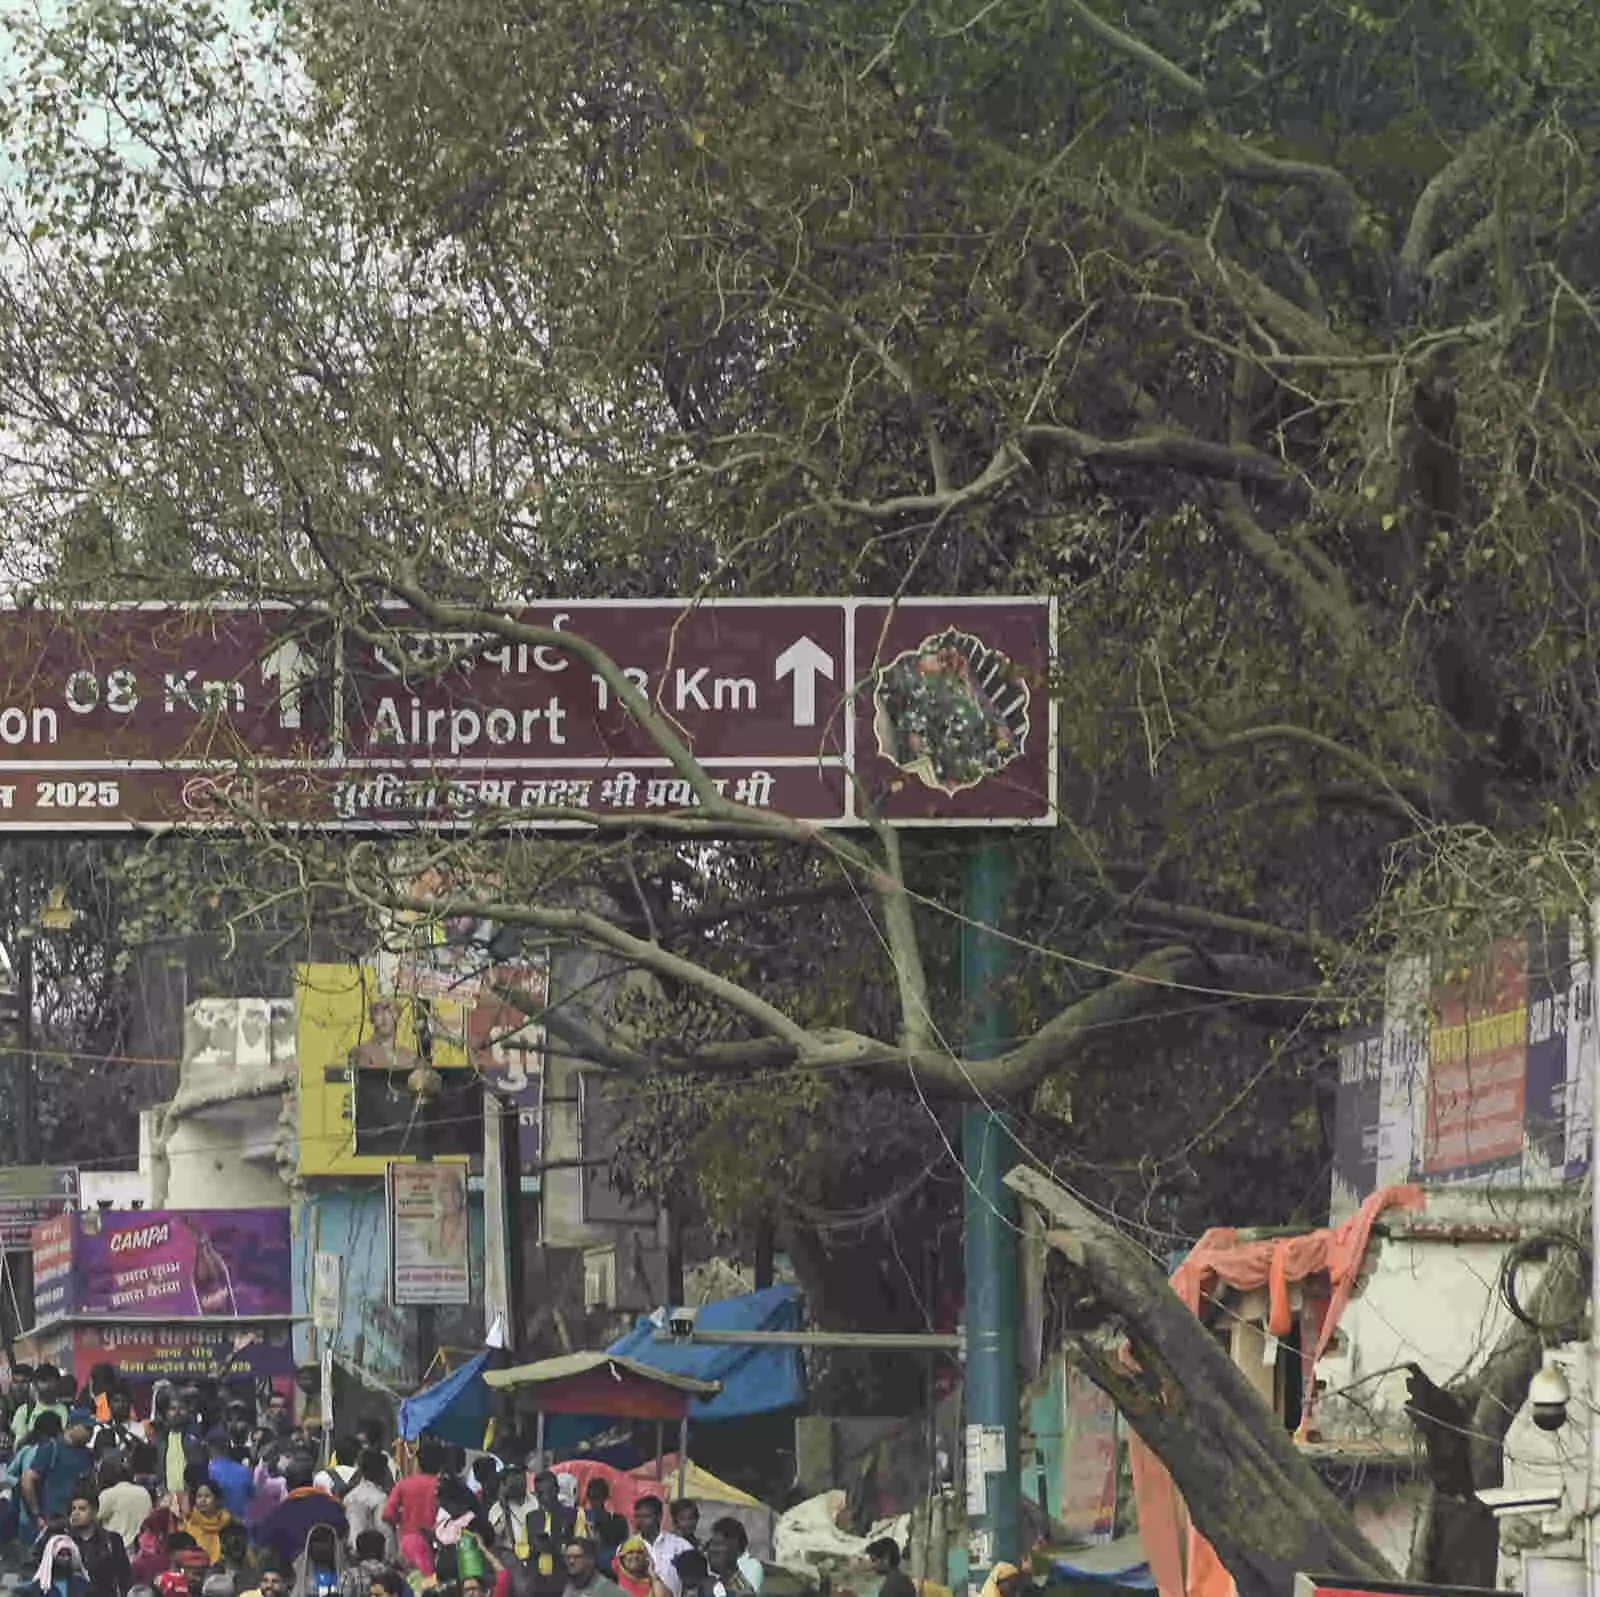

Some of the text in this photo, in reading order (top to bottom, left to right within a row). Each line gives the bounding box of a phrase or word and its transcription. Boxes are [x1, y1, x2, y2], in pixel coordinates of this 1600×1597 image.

[66, 668, 244, 713] 08 Km
[677, 668, 756, 709] Km
[370, 698, 565, 753] Airport
[37, 782, 119, 807] 2025
[601, 772, 640, 807] भी
[646, 779, 728, 807] प्रया
[735, 771, 775, 806] भी
[110, 1223, 169, 1252] CAMPA
